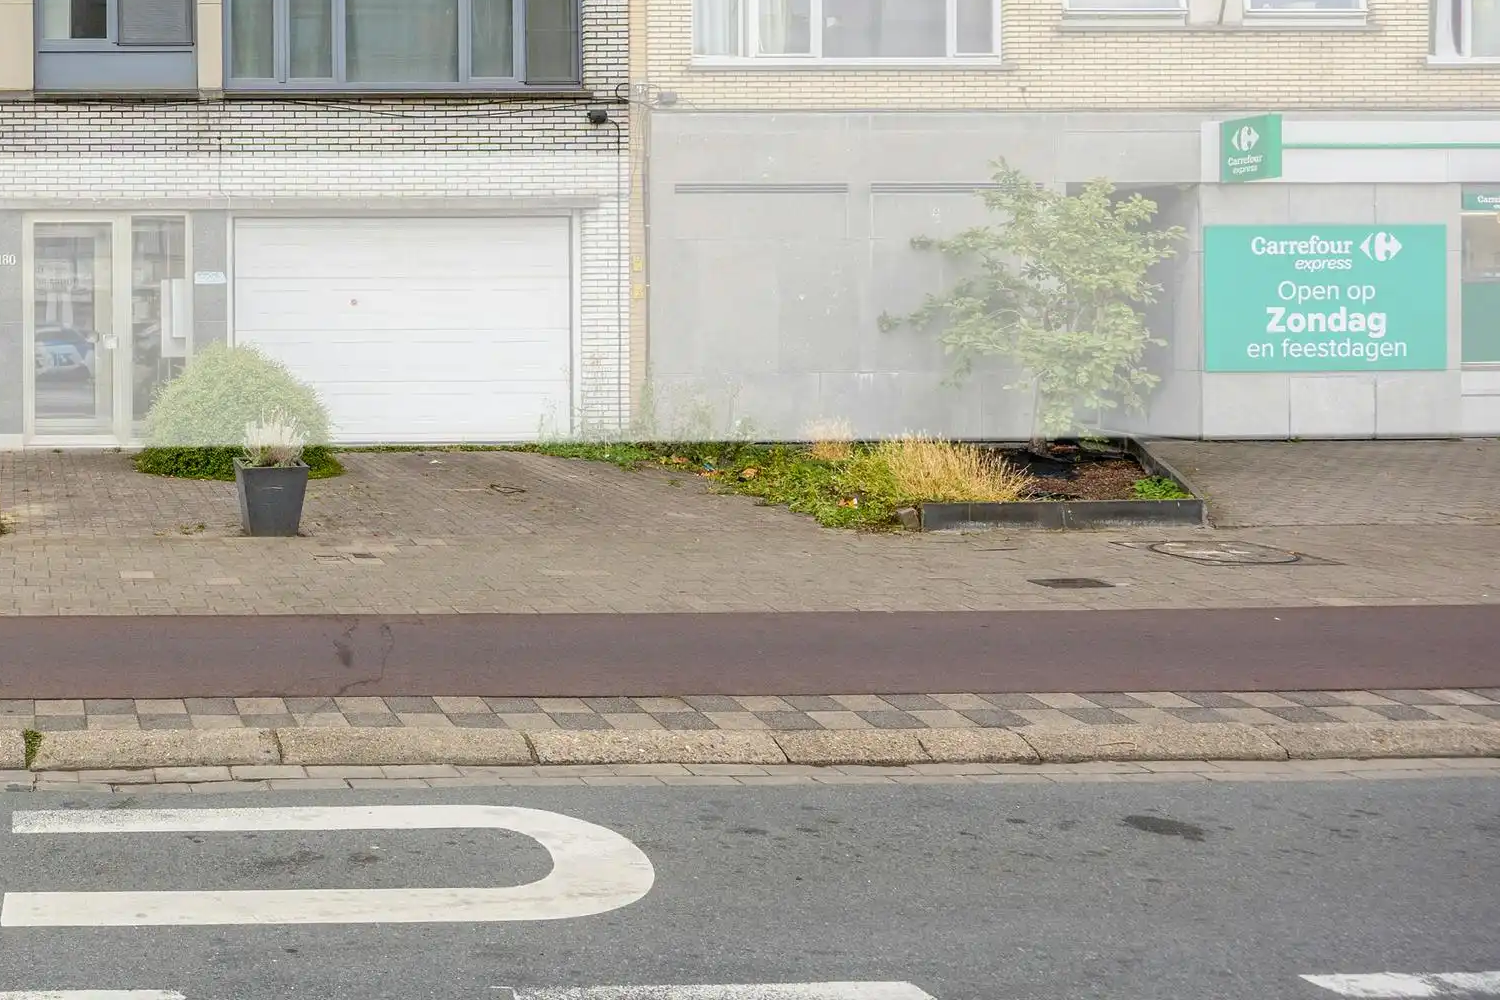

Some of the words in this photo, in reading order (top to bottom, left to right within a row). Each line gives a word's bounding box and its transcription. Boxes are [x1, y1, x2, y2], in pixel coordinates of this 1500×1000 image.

[1227, 154, 1263, 167] Carrefour
[1250, 235, 1354, 255] Carrefour
[1294, 258, 1353, 273] express
[1277, 280, 1341, 305] Open
[1346, 284, 1376, 305] op
[1265, 306, 1387, 338] Zondag
[1246, 342, 1274, 358] en
[1281, 338, 1408, 362] feestdagen
